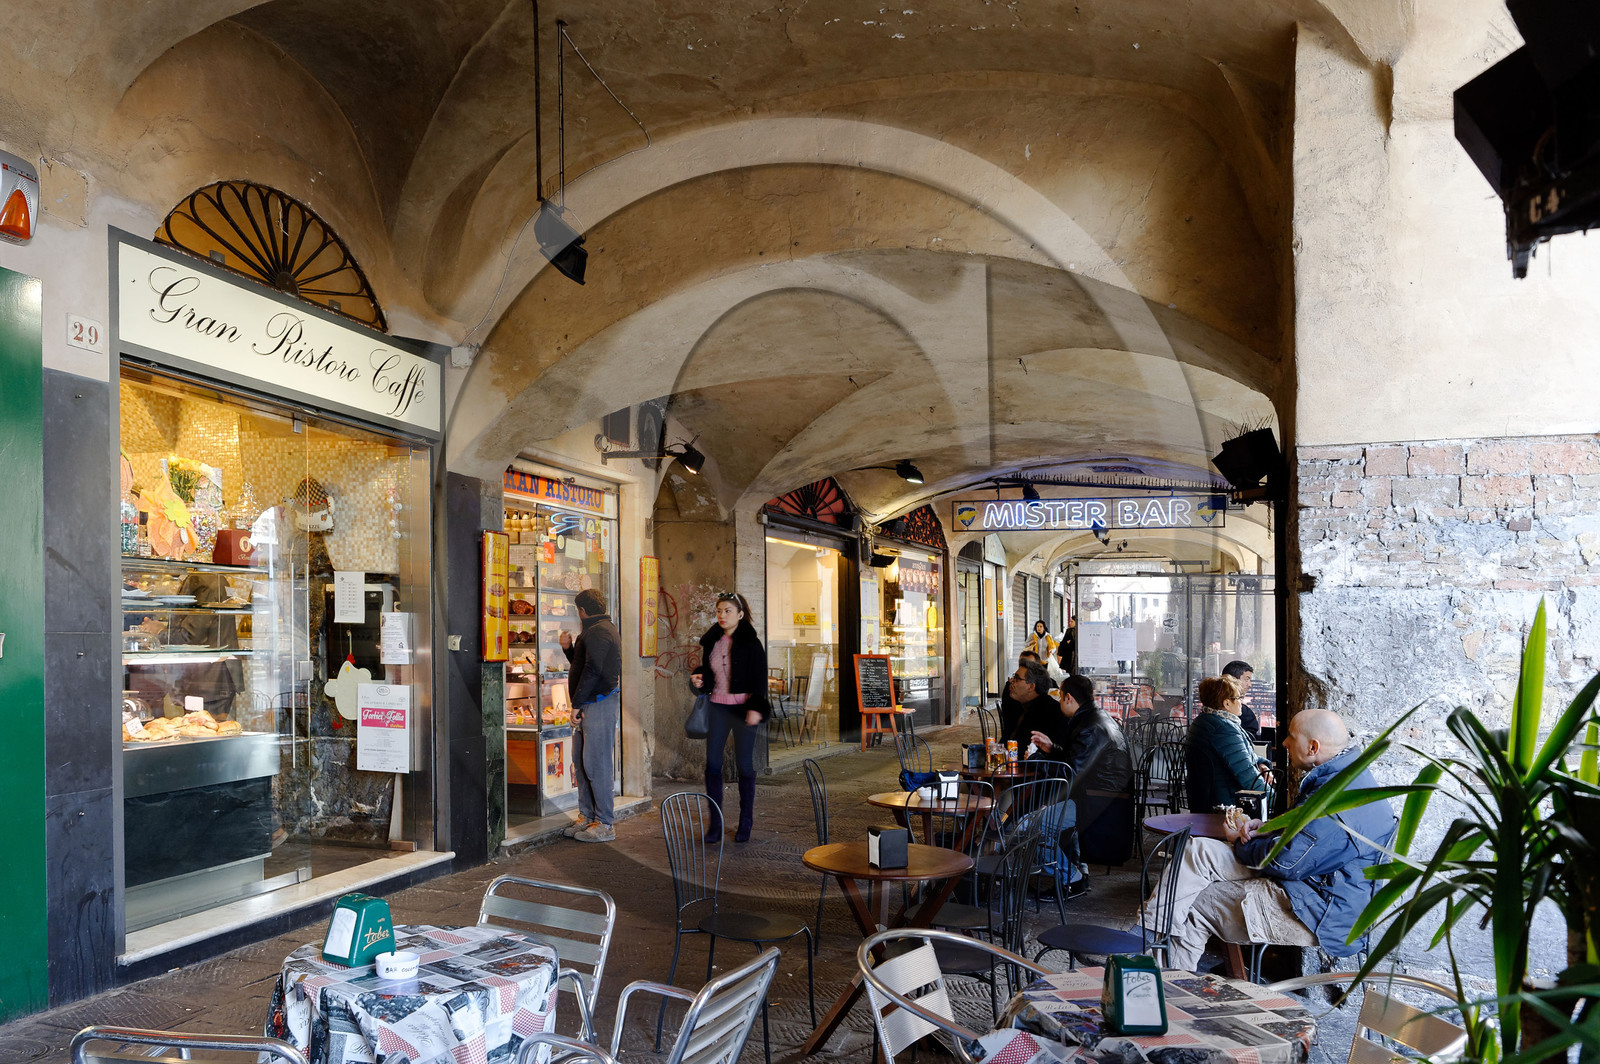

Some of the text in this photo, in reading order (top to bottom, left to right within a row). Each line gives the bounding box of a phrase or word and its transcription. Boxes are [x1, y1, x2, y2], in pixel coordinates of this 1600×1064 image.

[72, 320, 99, 346] 29
[148, 266, 426, 417] Gran Ristoro Caffè
[545, 479, 602, 508] RISTORO
[983, 498, 1192, 529] MISTER BAR
[363, 926, 391, 950] tober
